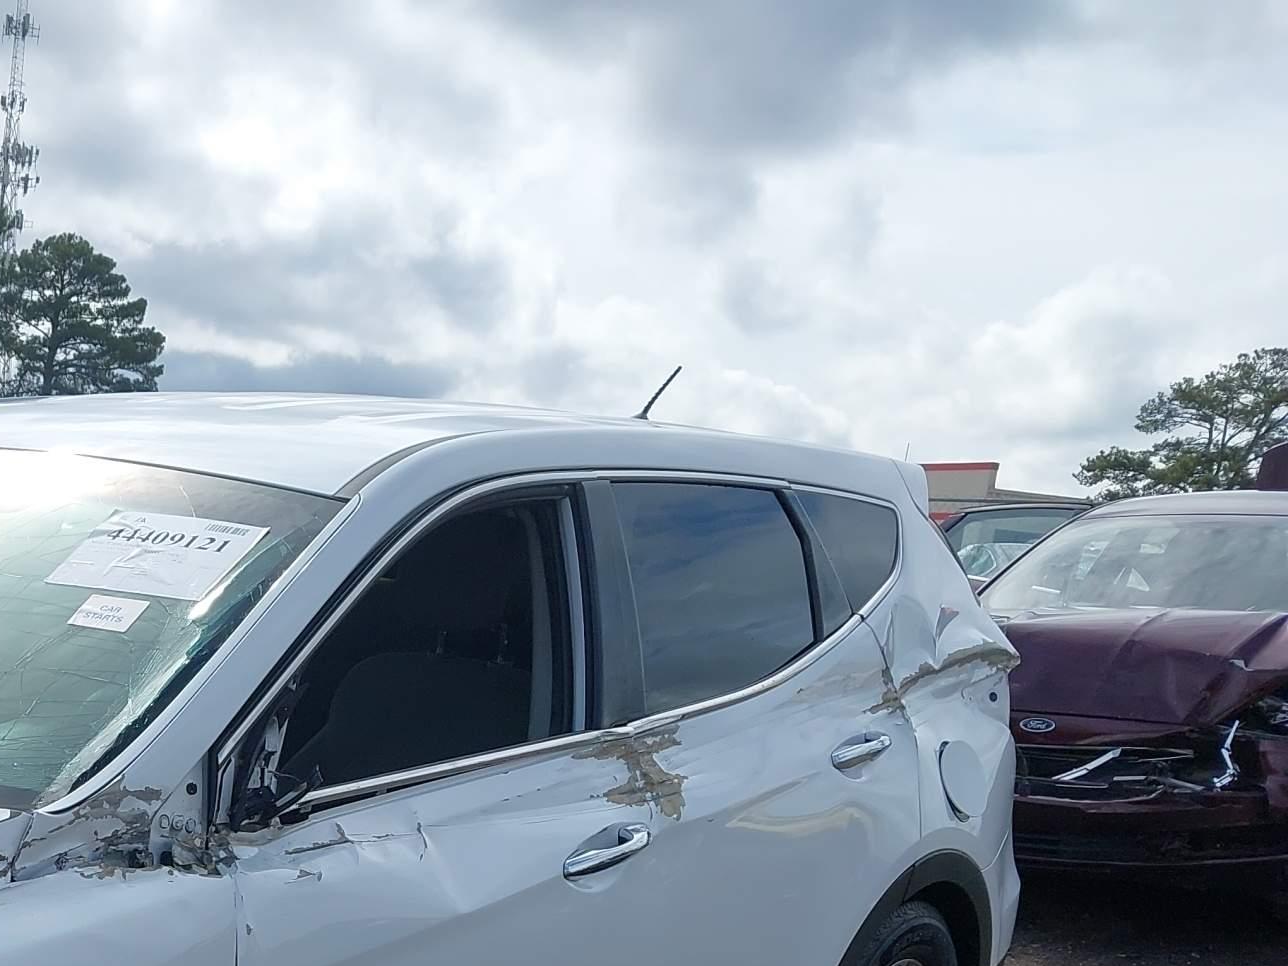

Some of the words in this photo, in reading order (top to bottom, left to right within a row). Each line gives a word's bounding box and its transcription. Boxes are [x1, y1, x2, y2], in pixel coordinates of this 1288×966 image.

[107, 527, 232, 552] 44409121
[99, 604, 122, 613] CAR
[83, 611, 124, 623] STARTS
